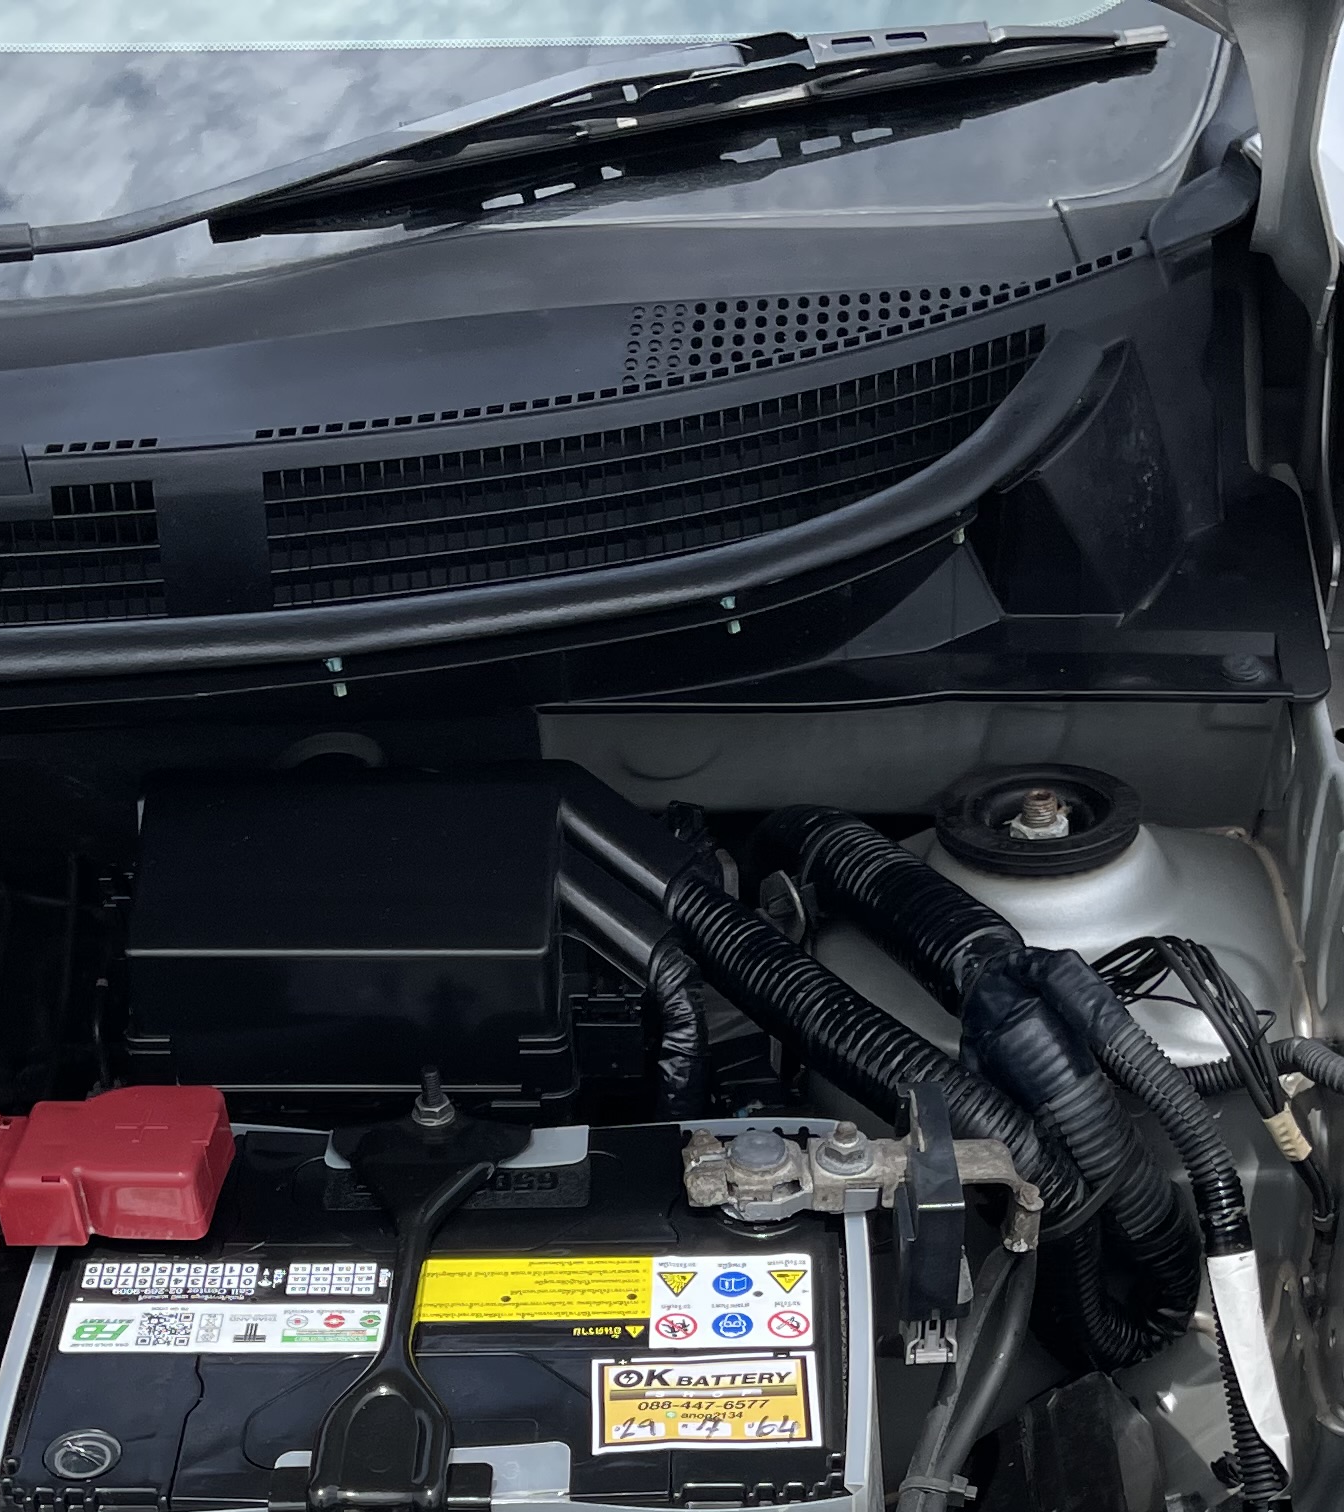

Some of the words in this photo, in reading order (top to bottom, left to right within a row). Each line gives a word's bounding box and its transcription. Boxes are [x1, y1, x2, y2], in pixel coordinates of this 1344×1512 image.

[72, 1324, 129, 1341] FB
[572, 1325, 622, 1338] อันตราย
[613, 1369, 674, 1388] OK
[676, 1372, 792, 1387] BATTERY
[637, 1400, 770, 1411] 088-447-6577
[619, 1416, 656, 1440] 29
[756, 1416, 801, 1442] 64
